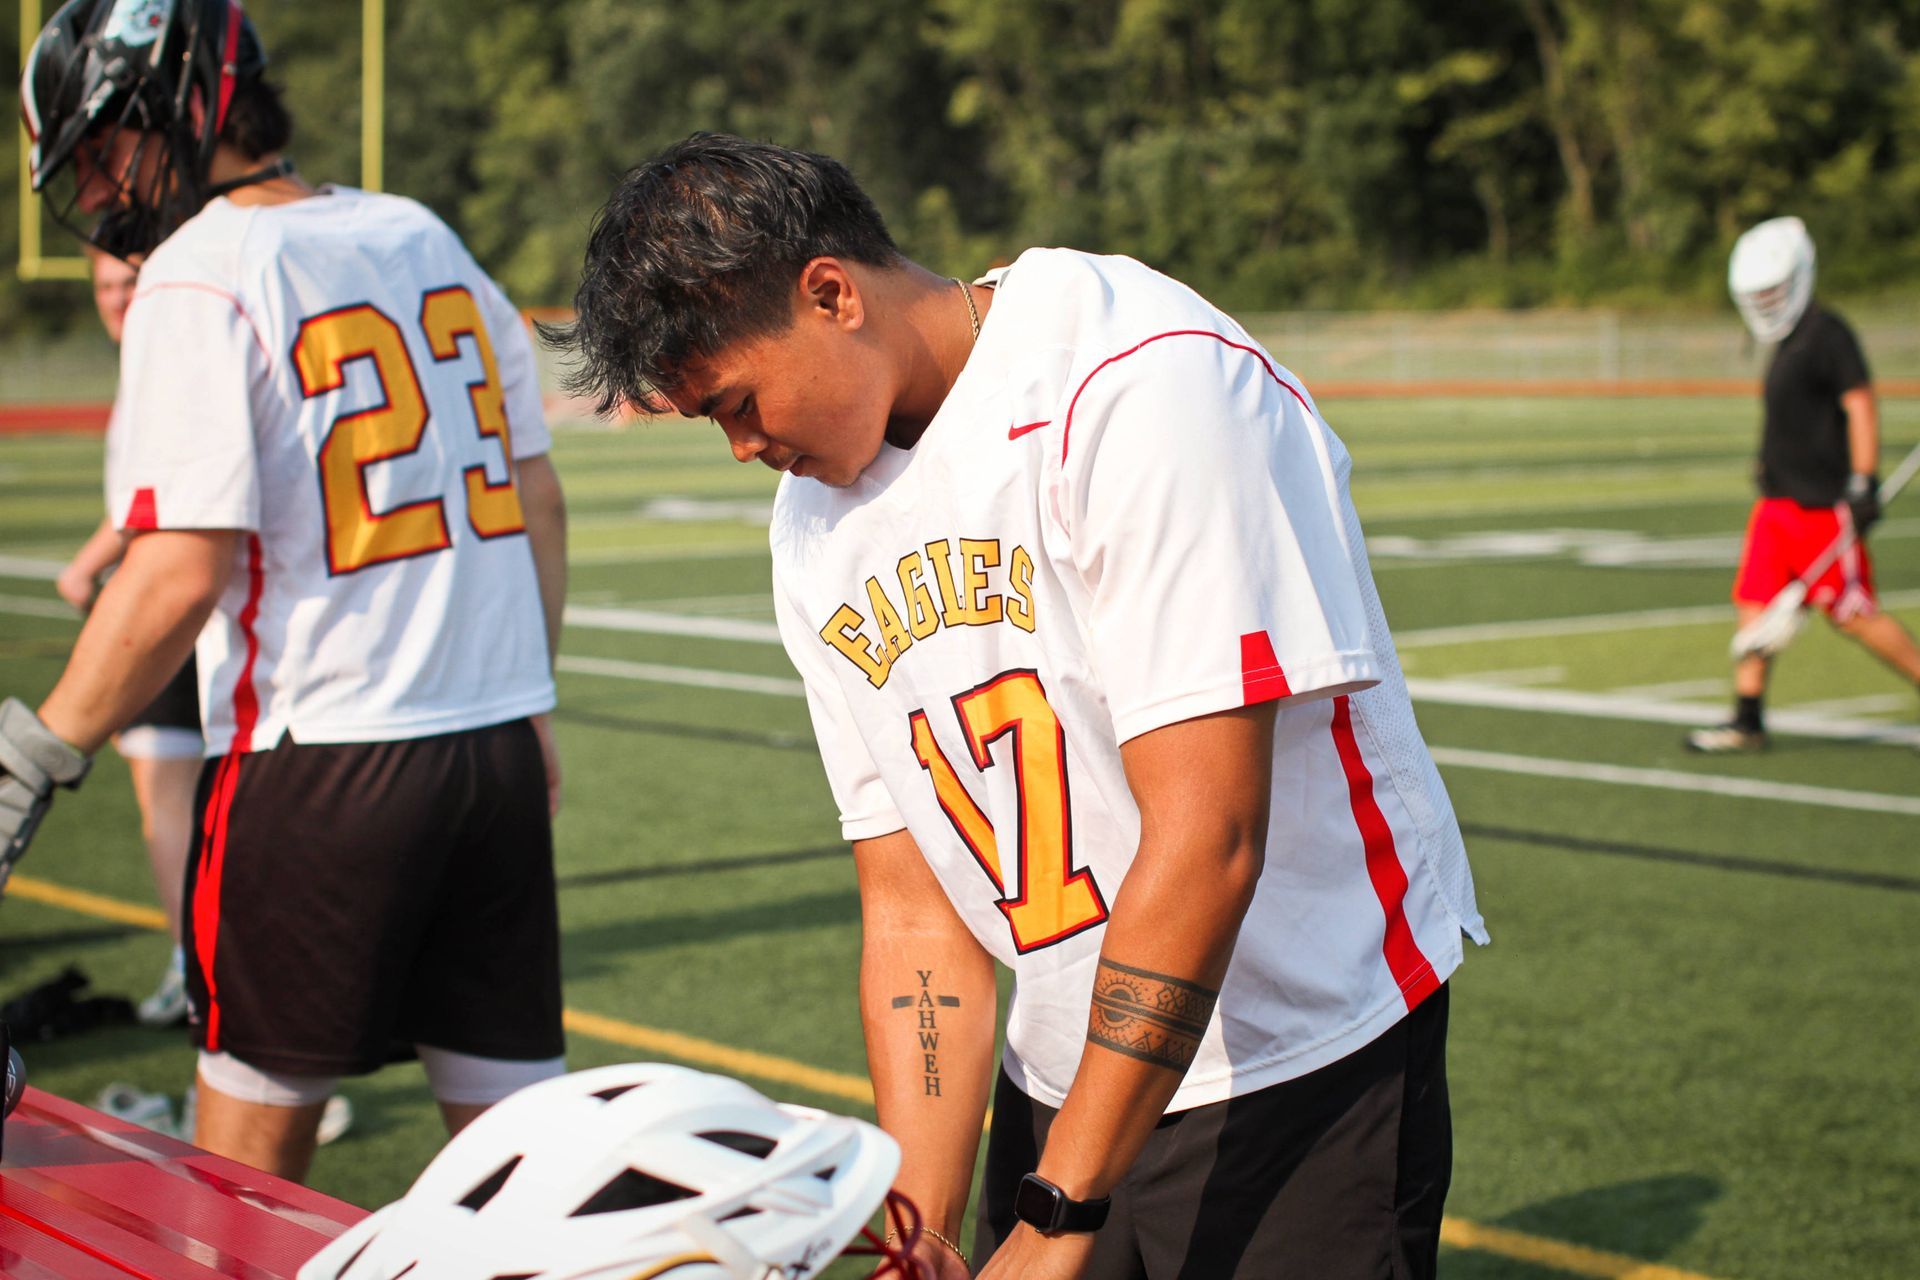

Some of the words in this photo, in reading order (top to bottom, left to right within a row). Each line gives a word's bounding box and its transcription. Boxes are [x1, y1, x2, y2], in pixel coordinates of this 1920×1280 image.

[291, 285, 526, 577] 23
[819, 538, 1036, 689] EAGLES
[908, 668, 1109, 955] 17
[916, 970, 942, 1097] YAHWEH
